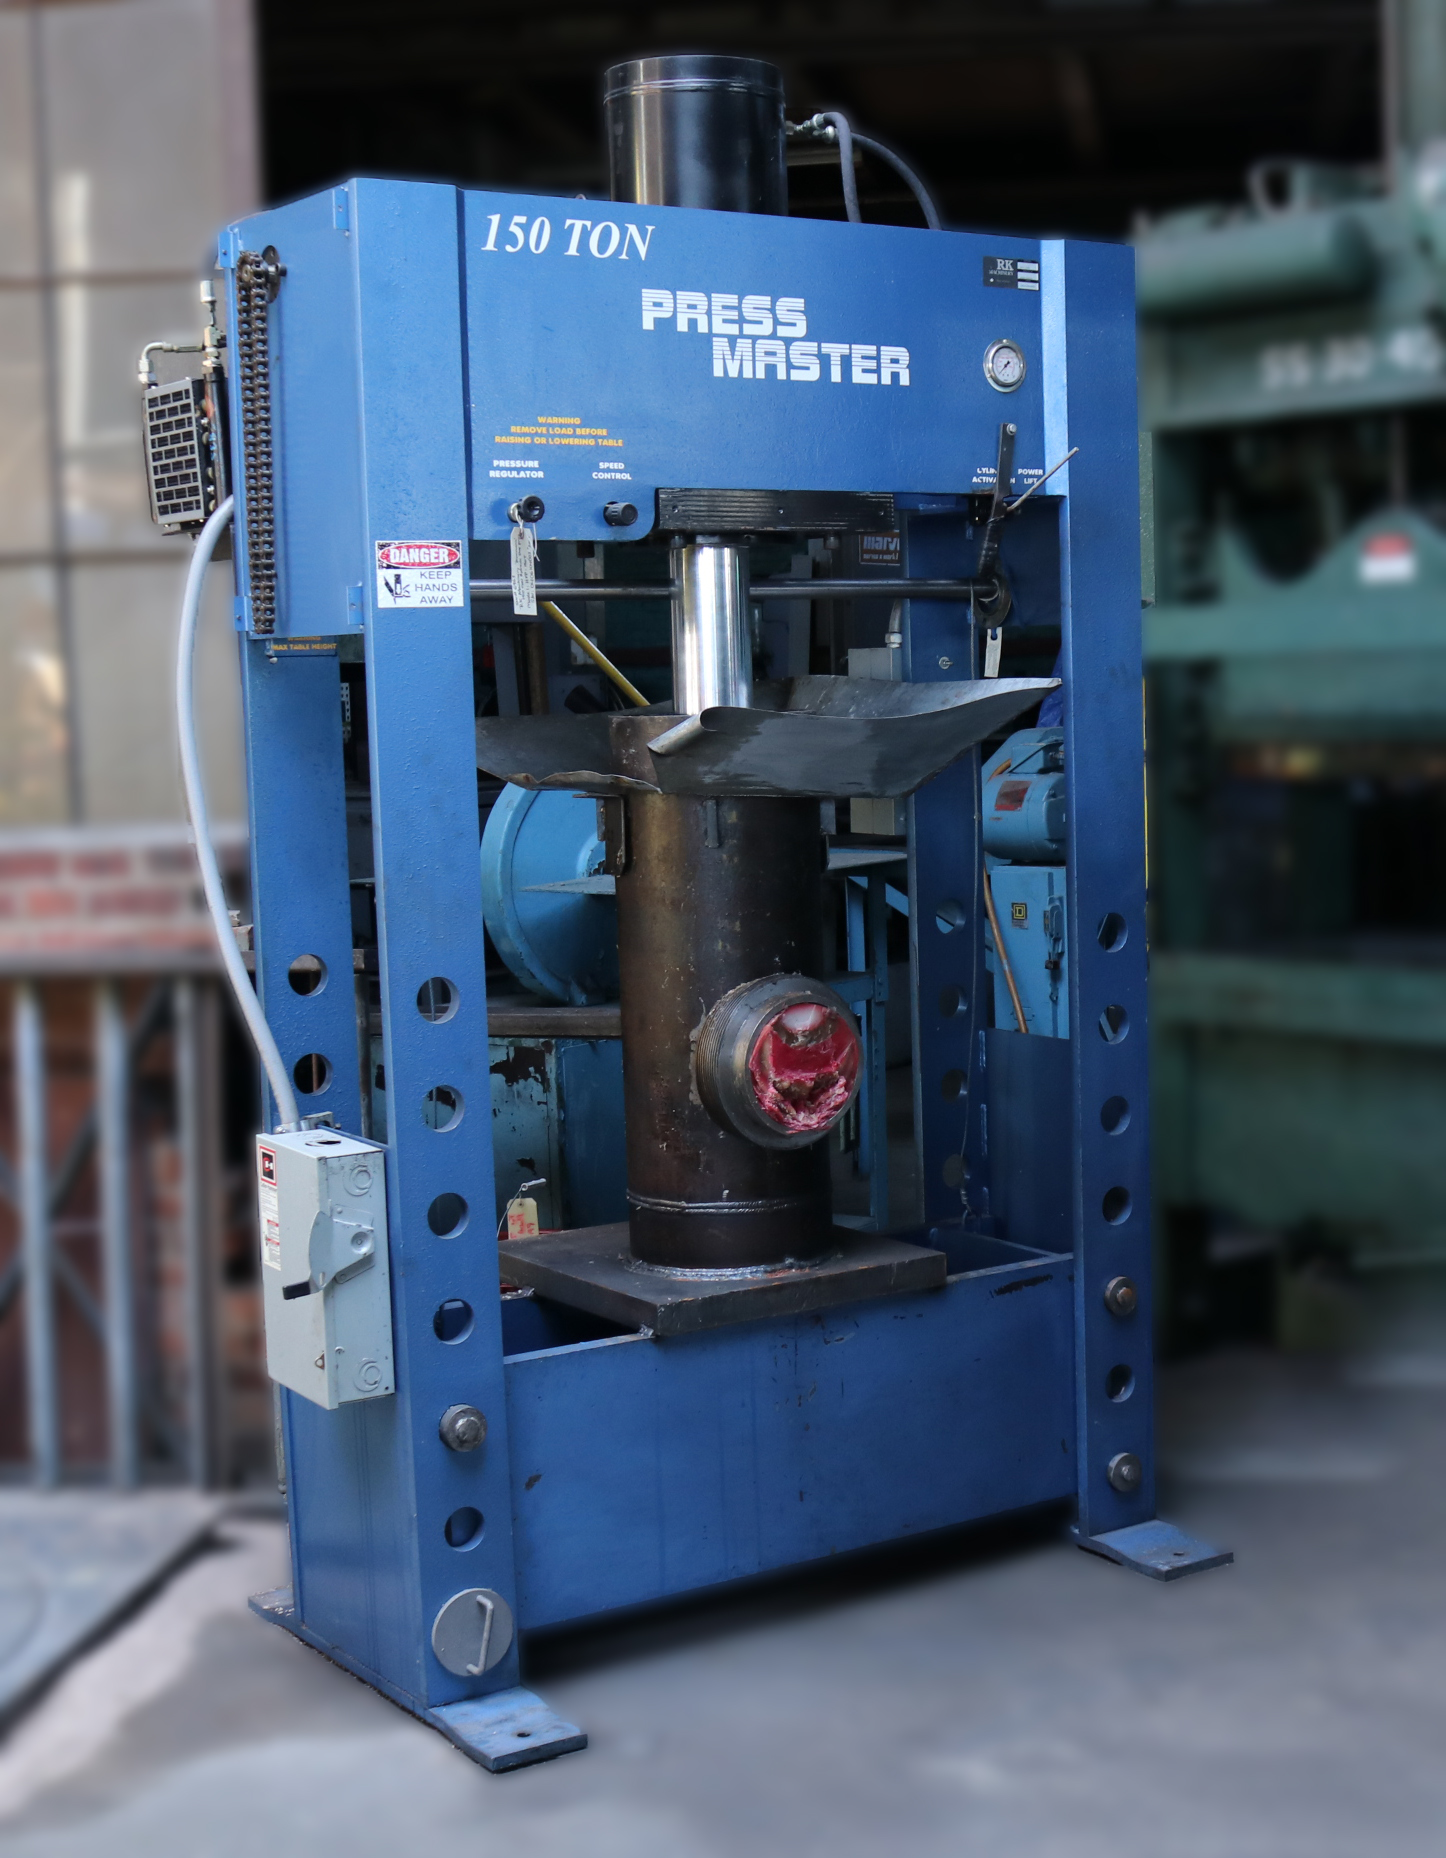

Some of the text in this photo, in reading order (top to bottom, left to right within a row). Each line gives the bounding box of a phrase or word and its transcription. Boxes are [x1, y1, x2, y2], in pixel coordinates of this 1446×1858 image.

[480, 213, 656, 261] 150 TON
[996, 258, 1014, 271] RK
[641, 288, 807, 338] PRESS
[712, 337, 910, 386] MASTER
[538, 416, 581, 424] WARNING
[510, 425, 608, 436] REMOVE LOAD BEFORE
[495, 435, 623, 447] RAISING OR LOWERING TABLE
[493, 460, 539, 468] PRESSURE
[598, 461, 625, 470] SPEED
[489, 470, 544, 479] REGULATOR
[592, 472, 632, 480] CONTROL
[1017, 468, 1044, 476] POWER
[1023, 477, 1038, 485] LIFT
[389, 548, 449, 563] DANGER
[419, 570, 452, 580] KEEP
[414, 583, 458, 592] HANDS
[419, 595, 453, 604] AWAY
[311, 642, 337, 650] HEIGHT
